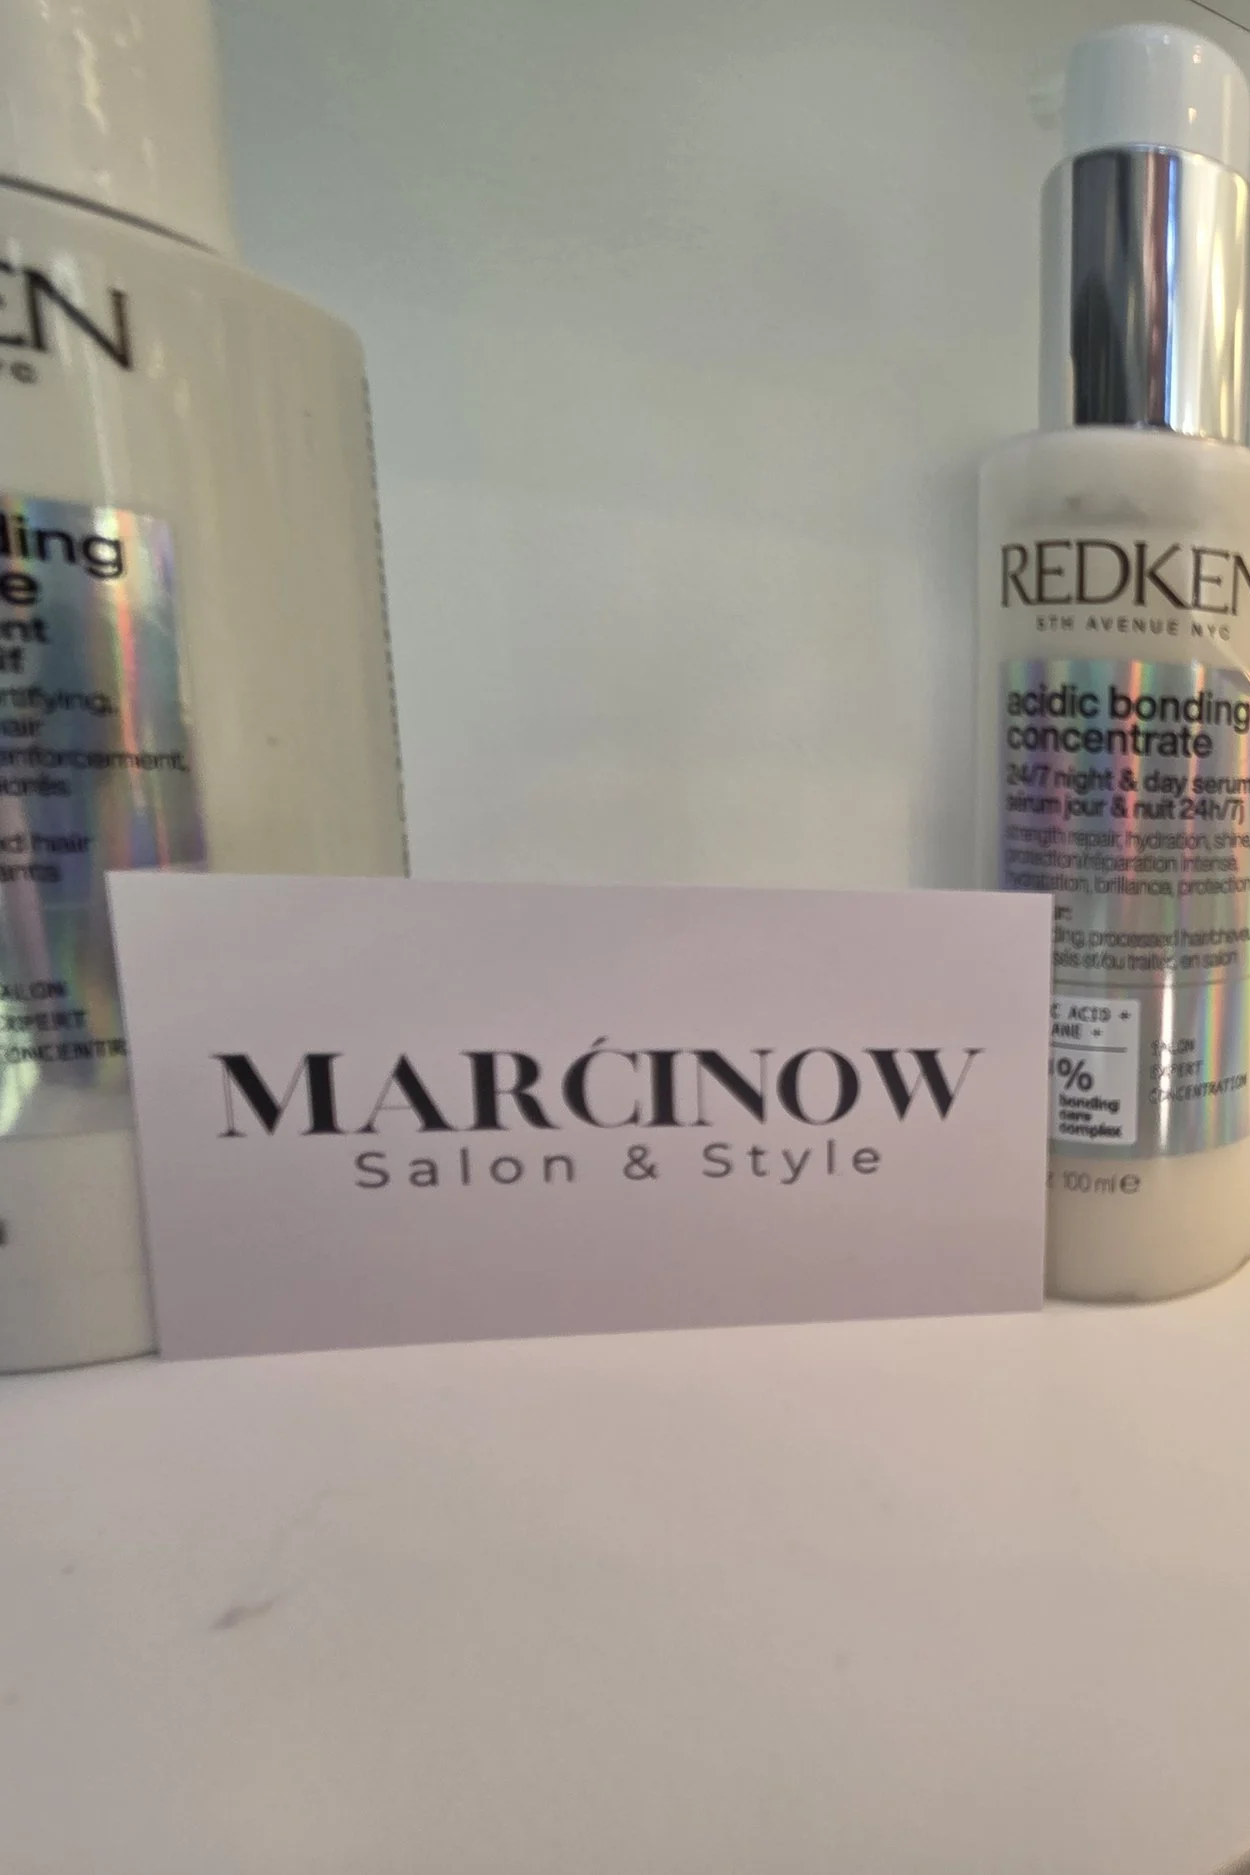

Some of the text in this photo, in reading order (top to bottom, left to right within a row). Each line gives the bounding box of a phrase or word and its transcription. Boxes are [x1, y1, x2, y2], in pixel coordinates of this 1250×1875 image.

[1086, 614, 1180, 637] AVENUE
[1190, 621, 1231, 641] NYC
[1006, 682, 1100, 718] acidic
[1006, 723, 1214, 759] concentrate
[1053, 766, 1115, 796] night
[1118, 767, 1138, 792] &
[1142, 769, 1190, 799] day
[1063, 794, 1107, 821] jour
[1110, 795, 1128, 819] &
[1133, 797, 1176, 820] nuit
[1067, 1004, 1112, 1023] ACID
[208, 1036, 985, 1138] MARĆINOW
[1058, 1092, 1121, 1115] bonding
[1058, 1109, 1093, 1124] care
[1057, 1122, 1124, 1140] complex
[355, 1138, 883, 1190] Salon & Style
